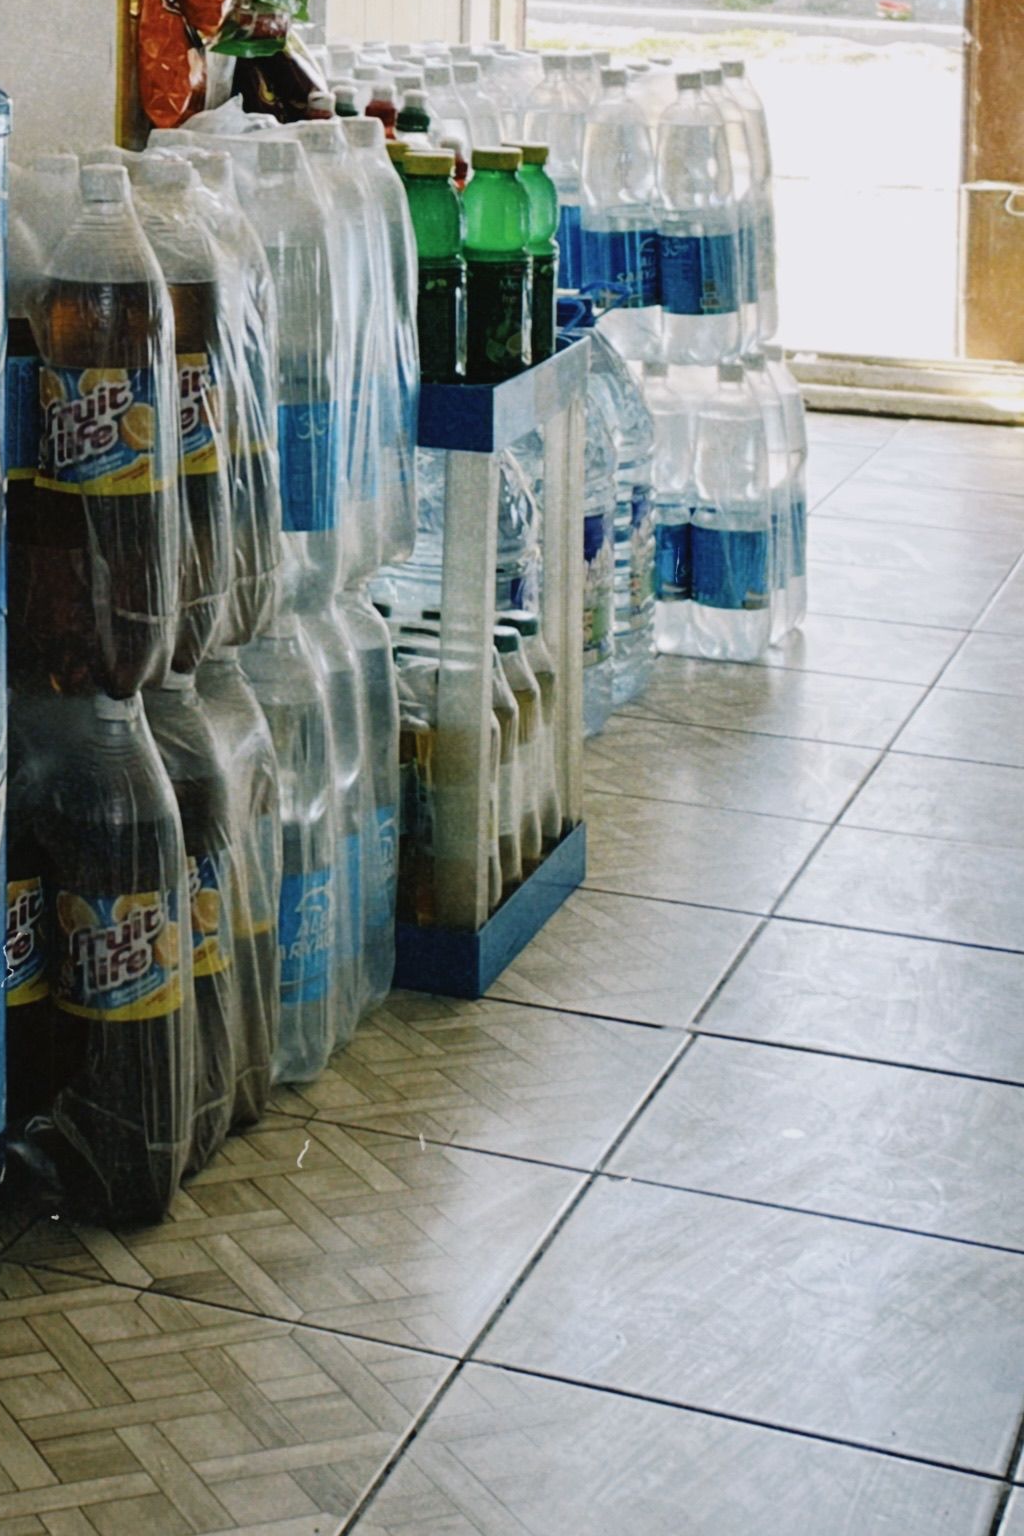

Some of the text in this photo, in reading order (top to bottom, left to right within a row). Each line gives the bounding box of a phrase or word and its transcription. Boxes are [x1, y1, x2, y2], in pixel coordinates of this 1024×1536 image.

[46, 382, 133, 431] fruit
[55, 421, 118, 466] life
[69, 904, 166, 966] fruit
[83, 942, 152, 994] life
